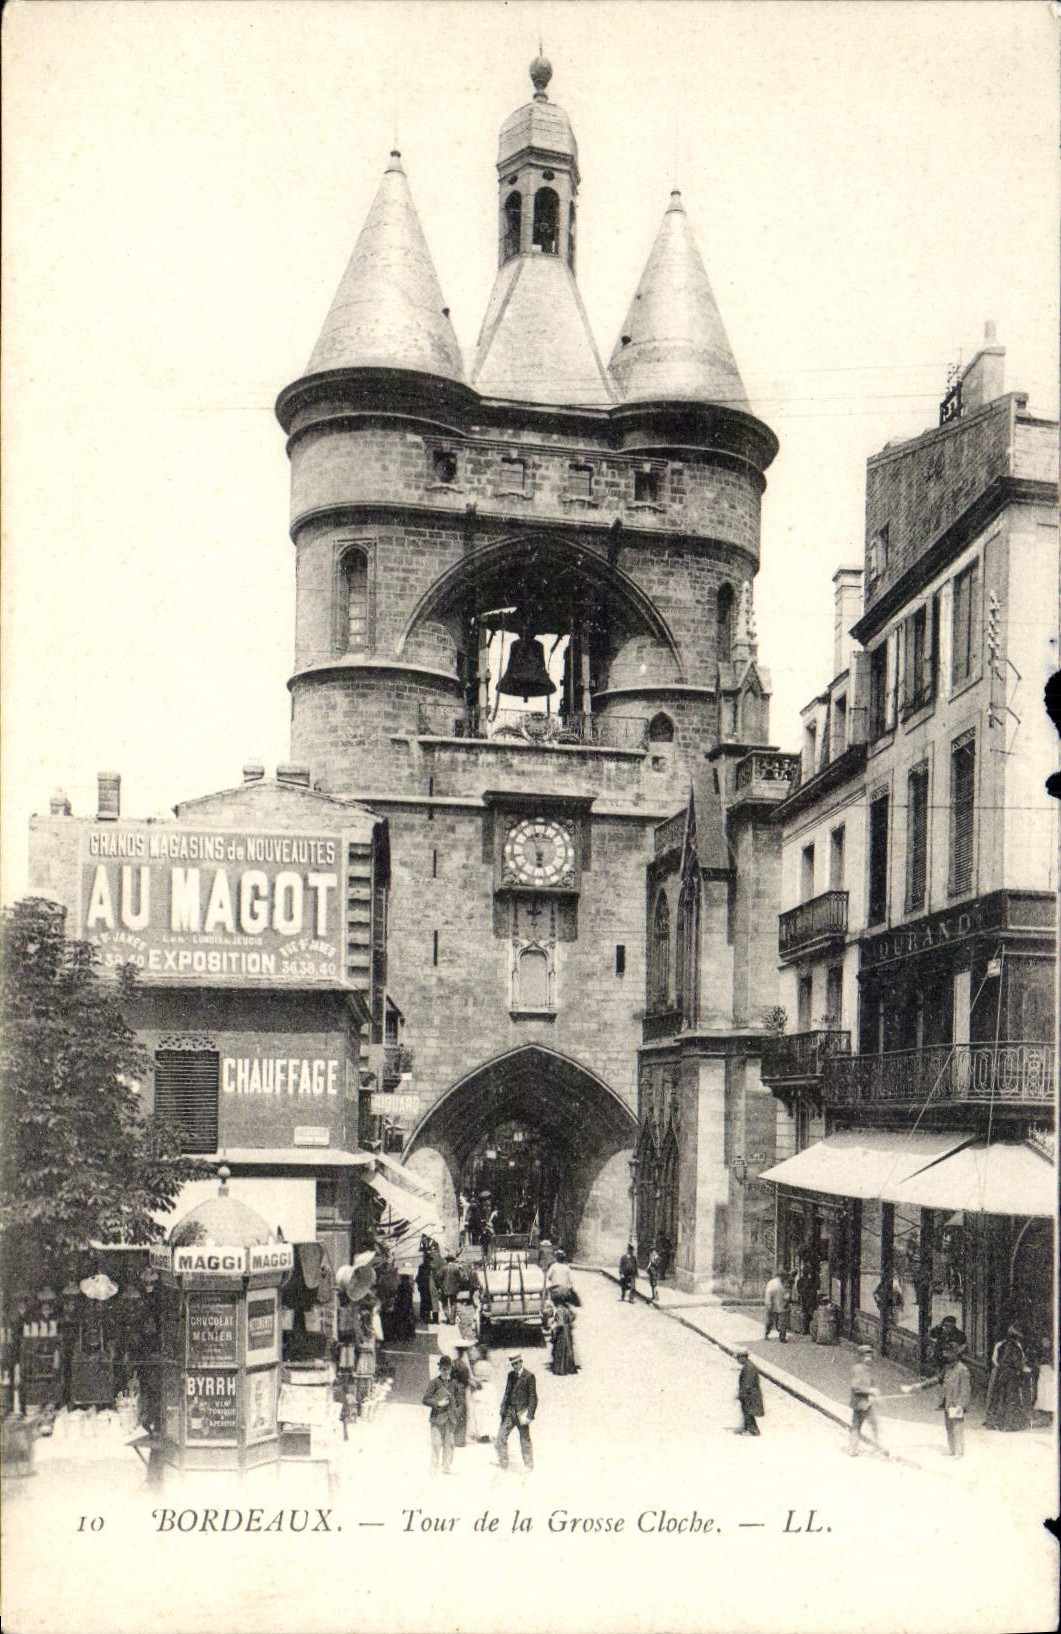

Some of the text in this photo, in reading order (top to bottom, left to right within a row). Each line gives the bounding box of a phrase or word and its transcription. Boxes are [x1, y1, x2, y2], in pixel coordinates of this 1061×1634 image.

[90, 832, 144, 857] GRANDS
[149, 834, 224, 861] MAGASINS
[227, 840, 244, 861] de
[87, 864, 338, 937] AU MAGOT
[149, 949, 275, 974] EXPOSITION
[223, 1057, 339, 1095] CHAUFFAGE
[178, 1255, 242, 1270] MAGGI
[252, 1252, 291, 1269] MAGGI
[190, 1316, 234, 1327] CHOCOLAT
[192, 1331, 232, 1342] MENIER
[187, 1376, 236, 1396] BYRRH
